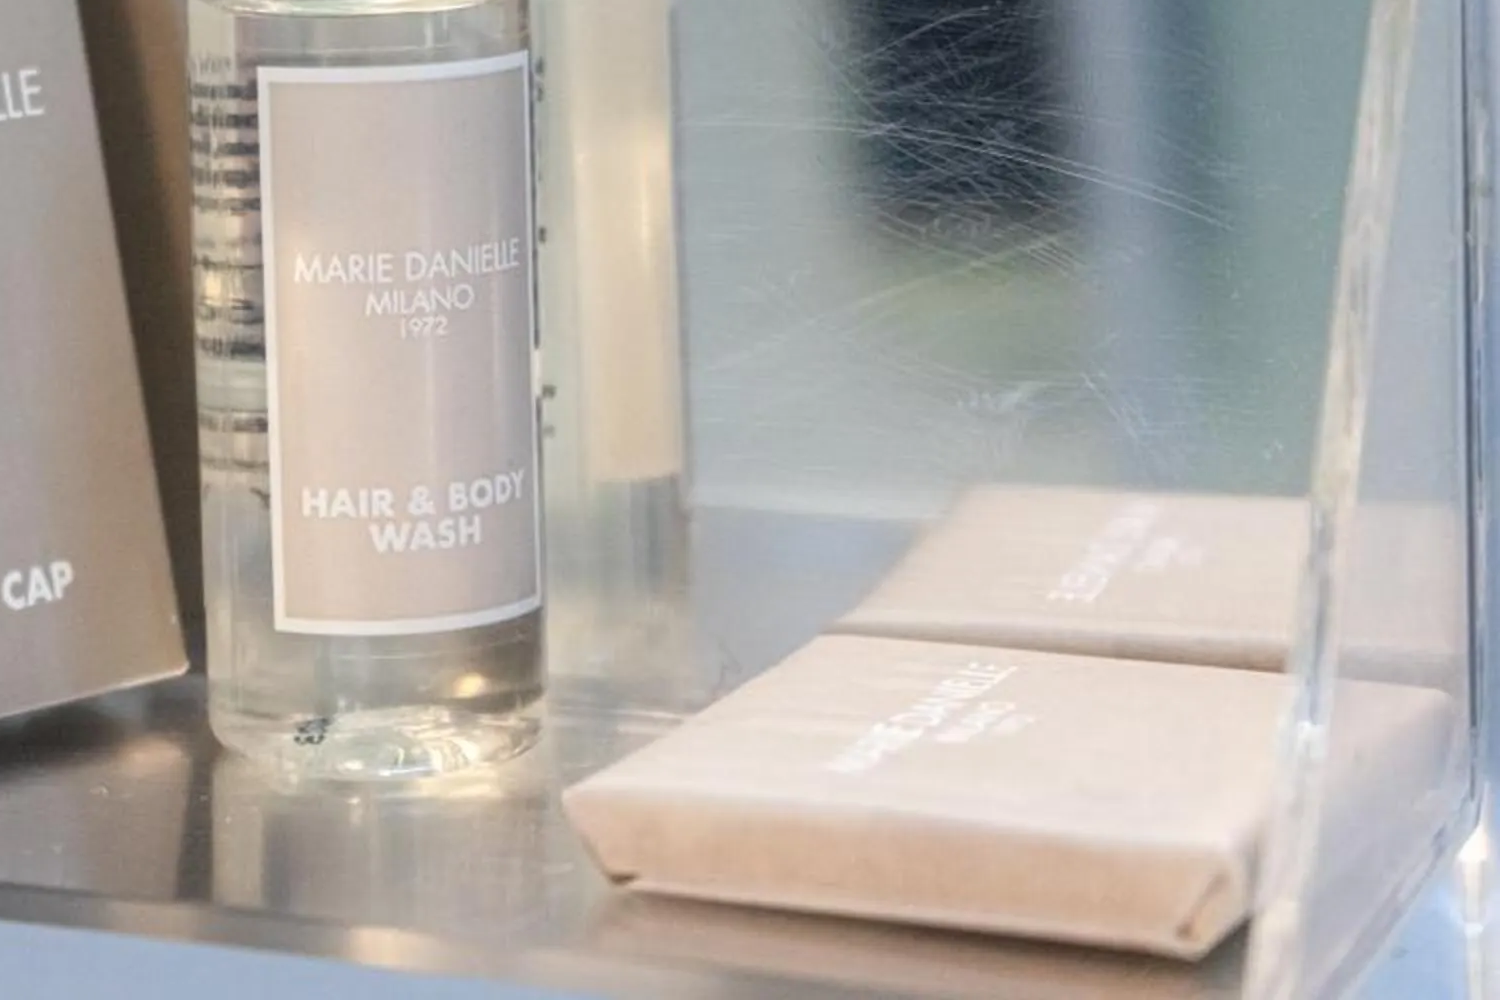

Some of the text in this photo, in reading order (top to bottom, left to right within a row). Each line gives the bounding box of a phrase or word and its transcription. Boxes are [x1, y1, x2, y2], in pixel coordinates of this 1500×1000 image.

[292, 237, 522, 284] MARIE DANIELLE
[364, 283, 475, 317] MILANO
[401, 314, 449, 339] 1972
[301, 468, 525, 519] HAIR & BODY
[368, 513, 483, 554] WASH
[1, 560, 75, 612] CAP
